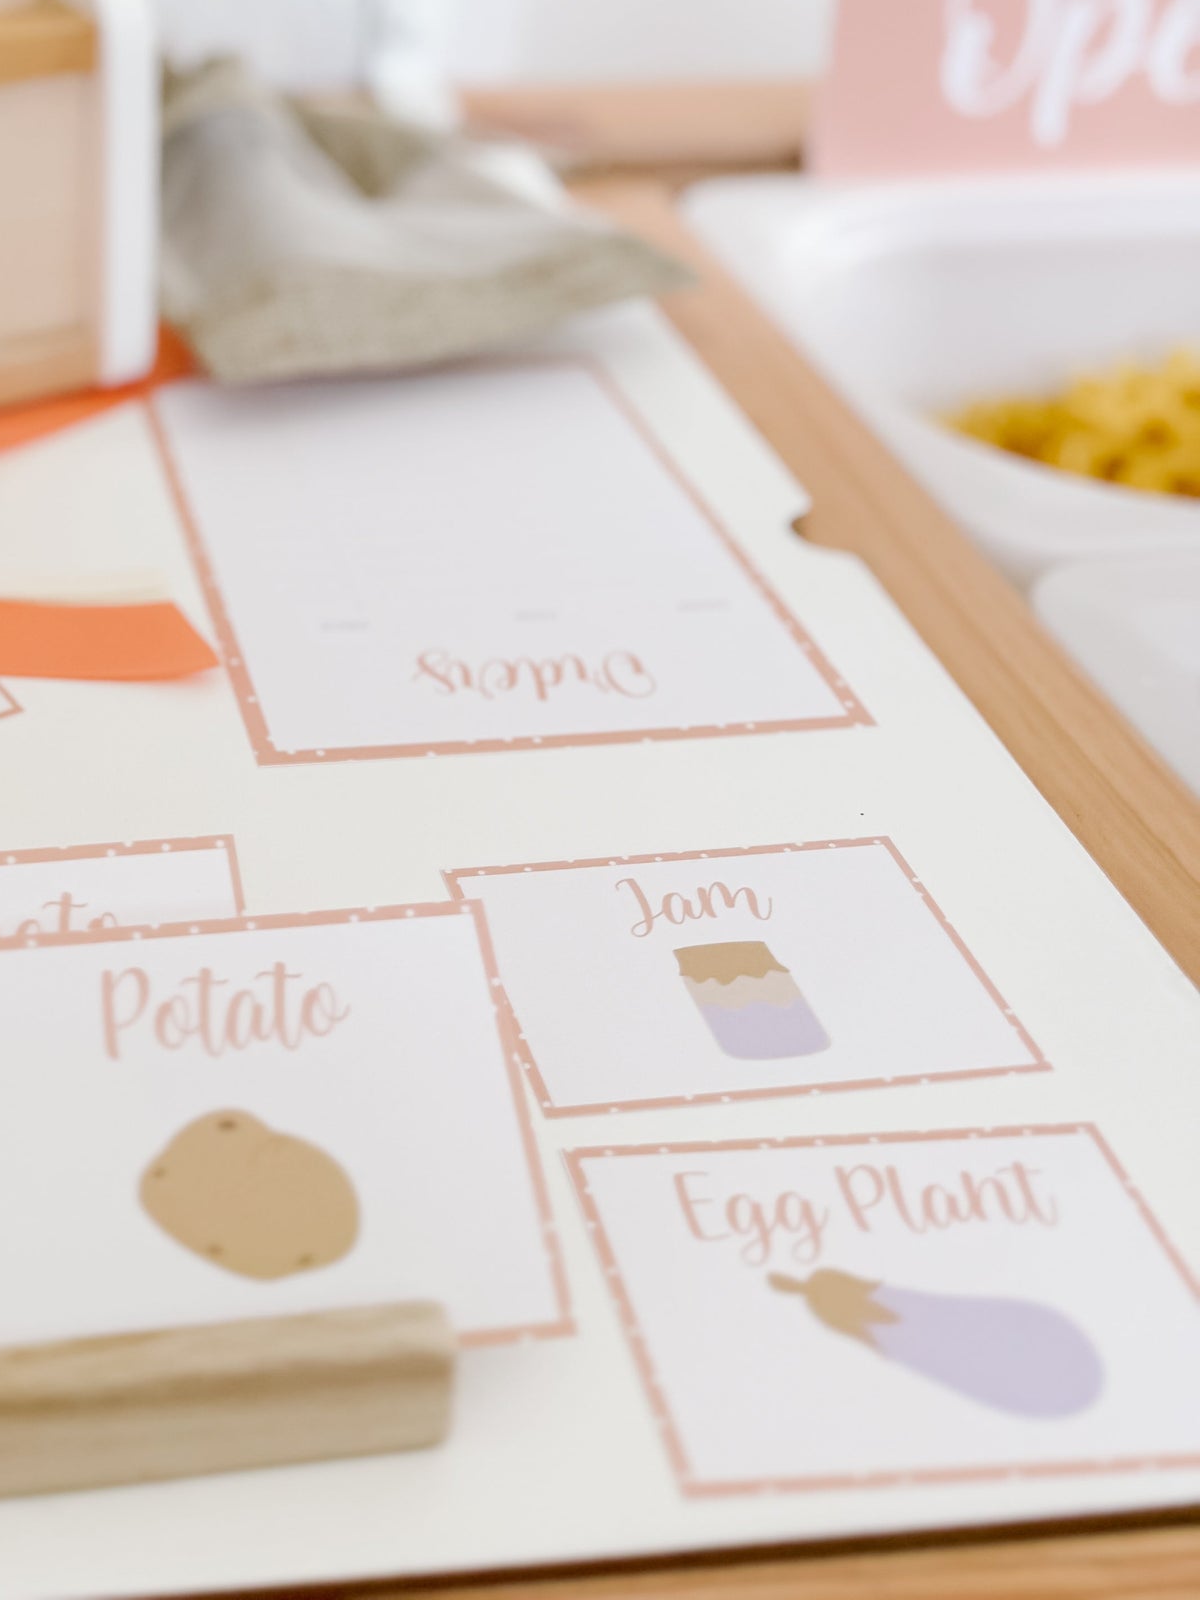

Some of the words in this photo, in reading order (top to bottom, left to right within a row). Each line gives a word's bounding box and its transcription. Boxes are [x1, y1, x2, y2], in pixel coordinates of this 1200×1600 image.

[410, 646, 658, 703] Orders
[614, 876, 774, 939] Jam
[97, 960, 352, 1062] Potato
[672, 1169, 832, 1266] Egg
[833, 1160, 1059, 1236] Plant
